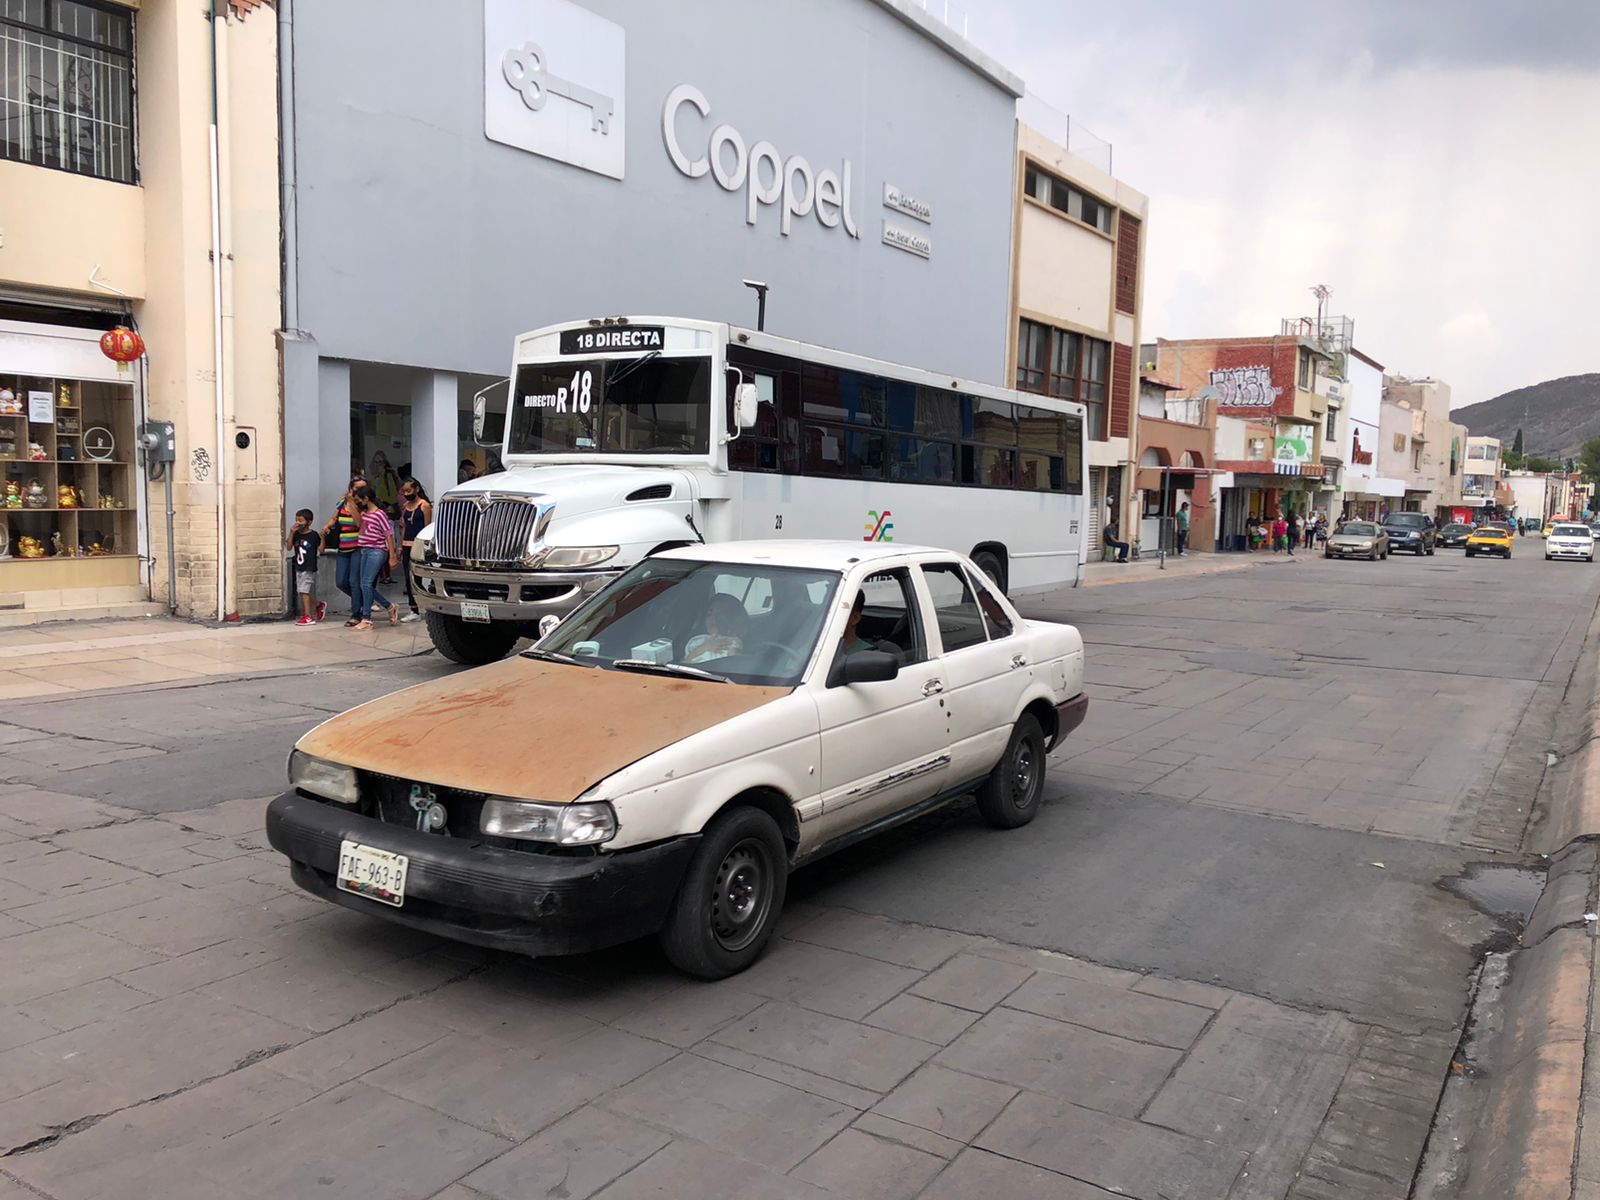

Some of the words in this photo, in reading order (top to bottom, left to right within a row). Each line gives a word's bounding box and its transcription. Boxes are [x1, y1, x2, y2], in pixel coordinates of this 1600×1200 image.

[661, 83, 862, 240] Coppel
[576, 333, 594, 349] 18
[596, 331, 661, 347] DIRECTA
[524, 394, 556, 408] DIRECTO
[556, 387, 568, 414] R
[570, 370, 593, 414] 18
[775, 514, 783, 530] 28
[340, 854, 403, 891] FAE-963-B
